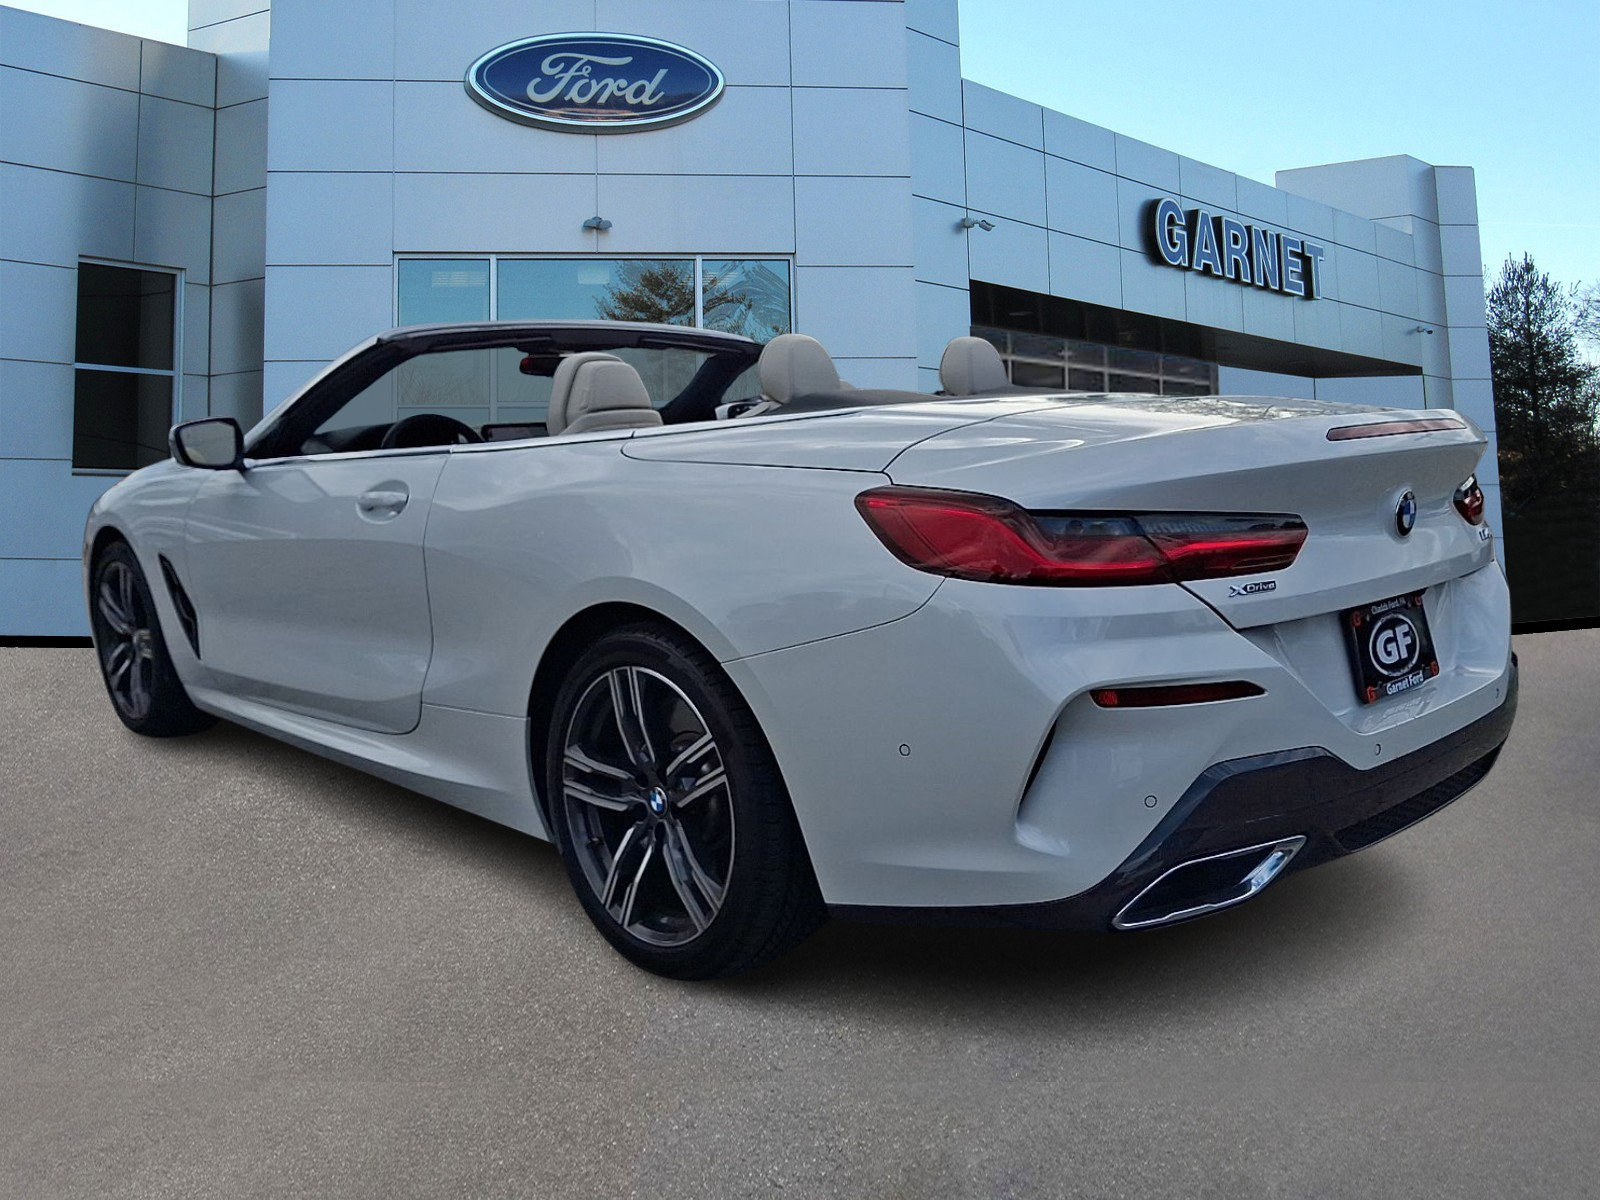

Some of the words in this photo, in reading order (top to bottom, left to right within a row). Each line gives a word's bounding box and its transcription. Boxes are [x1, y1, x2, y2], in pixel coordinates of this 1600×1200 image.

[526, 52, 669, 106] Ford
[1154, 197, 1325, 300] GARNET
[1376, 624, 1411, 664] GF
[1386, 676, 1410, 695] Garnet
[1408, 670, 1424, 687] Ford
